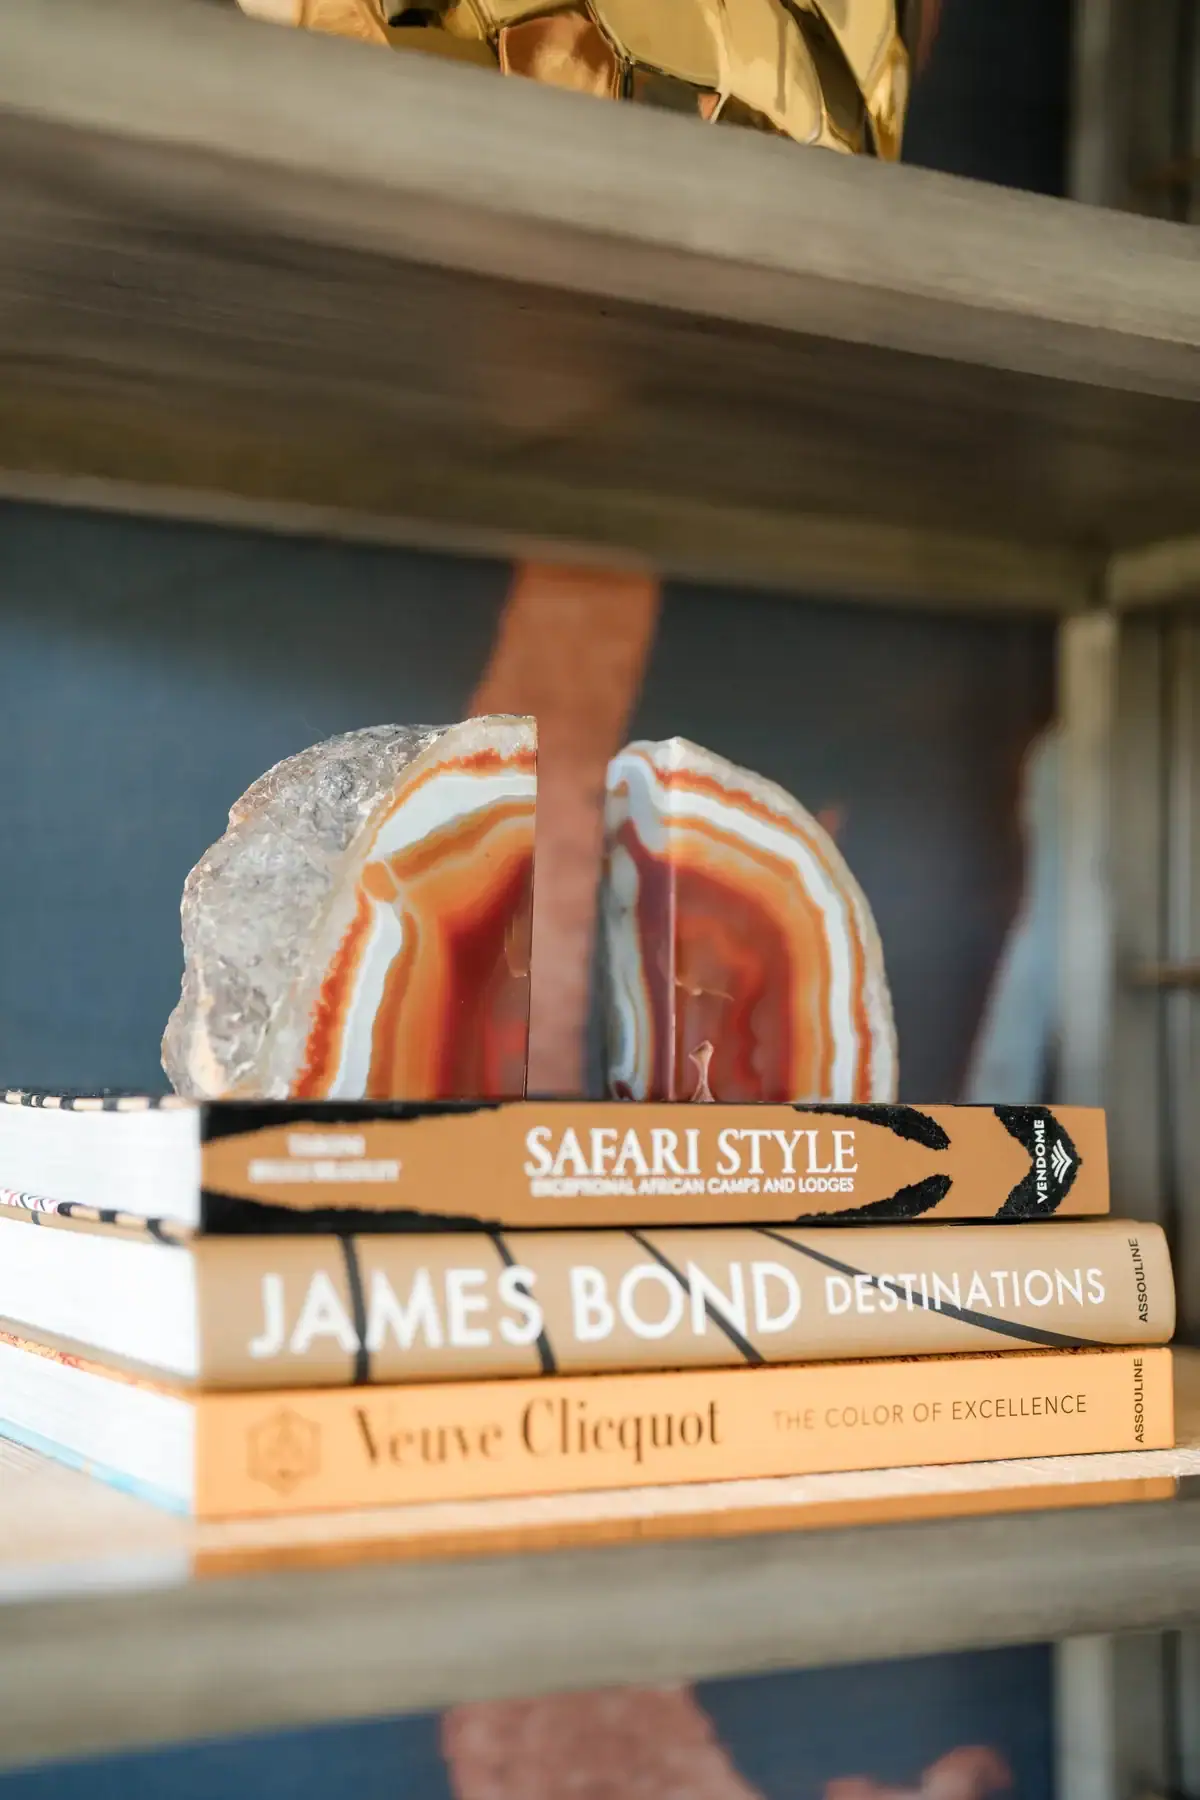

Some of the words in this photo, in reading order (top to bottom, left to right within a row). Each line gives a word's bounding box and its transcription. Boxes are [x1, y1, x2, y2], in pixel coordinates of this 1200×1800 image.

[523, 1125, 702, 1177] SAFARI
[716, 1127, 859, 1176] STYLE
[707, 1176, 760, 1195] CAMPS
[763, 1176, 796, 1193] AND
[798, 1177, 855, 1193] LODGES
[1034, 1118, 1048, 1205] VENDOME
[249, 1264, 542, 1358] JAMES
[570, 1260, 802, 1341] BOND
[824, 1267, 1106, 1316] DESTINATIONS
[1127, 1237, 1149, 1323] ASSOULINE
[352, 1402, 503, 1469] Veuve
[520, 1396, 723, 1465] Clicquot
[772, 1408, 817, 1432] THE
[824, 1403, 905, 1429] COLOR
[912, 1401, 943, 1424] OF
[951, 1393, 1088, 1421] EXCELLENCE
[1132, 1357, 1145, 1444] ASSOULINE
